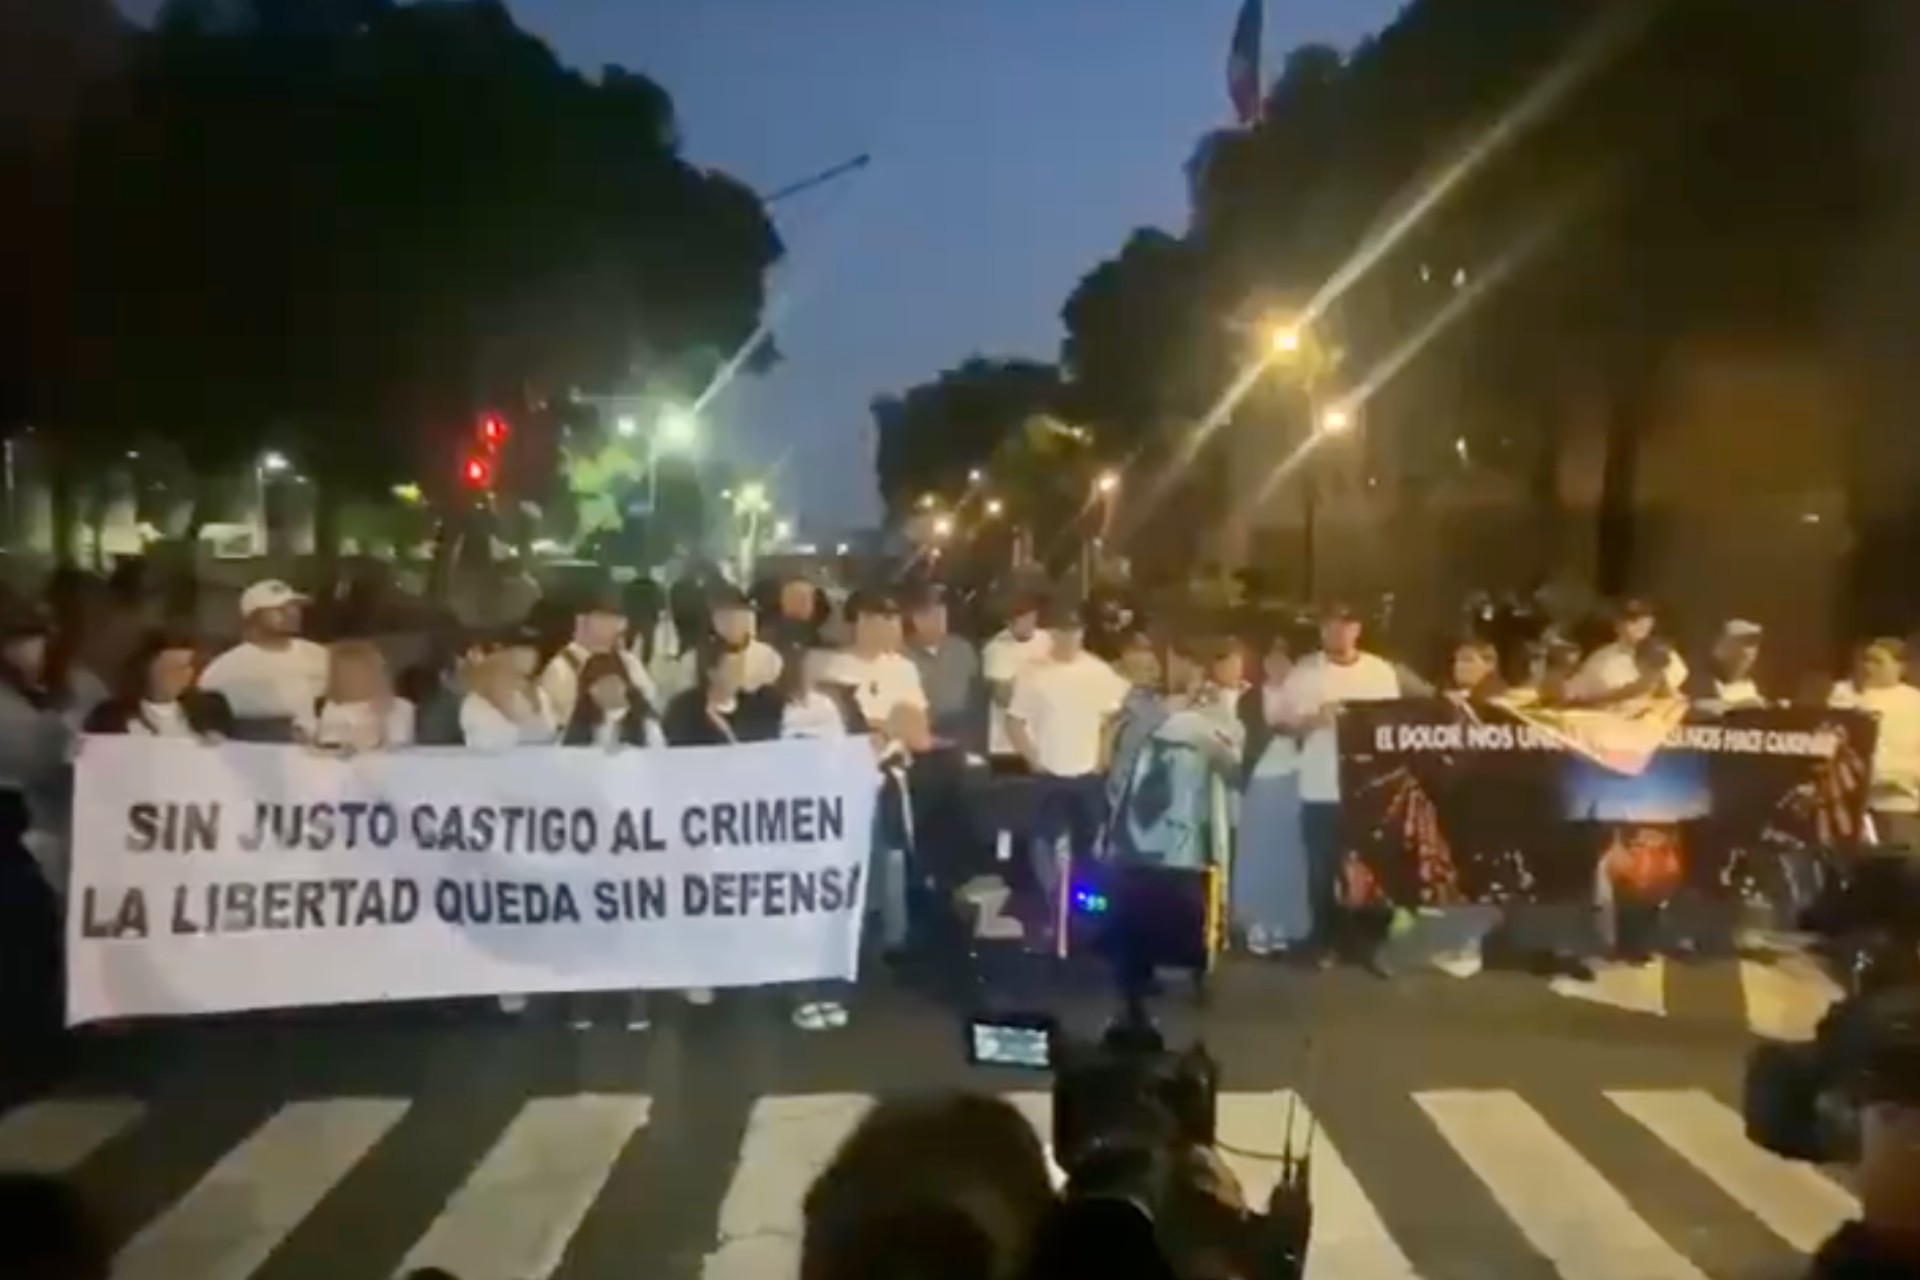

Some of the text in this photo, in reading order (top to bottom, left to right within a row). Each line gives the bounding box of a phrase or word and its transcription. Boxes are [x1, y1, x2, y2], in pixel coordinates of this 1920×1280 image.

[1375, 725, 1395, 750] EL
[1399, 723, 1463, 750] DOLOR
[1467, 724, 1514, 749] NOS
[126, 797, 845, 854] SIN JUSTO CASTIGO AL CRIMEN
[81, 886, 149, 939] LA
[171, 878, 419, 935] LIBERTAD
[435, 877, 581, 926] QUEDA
[594, 876, 667, 923] SIN
